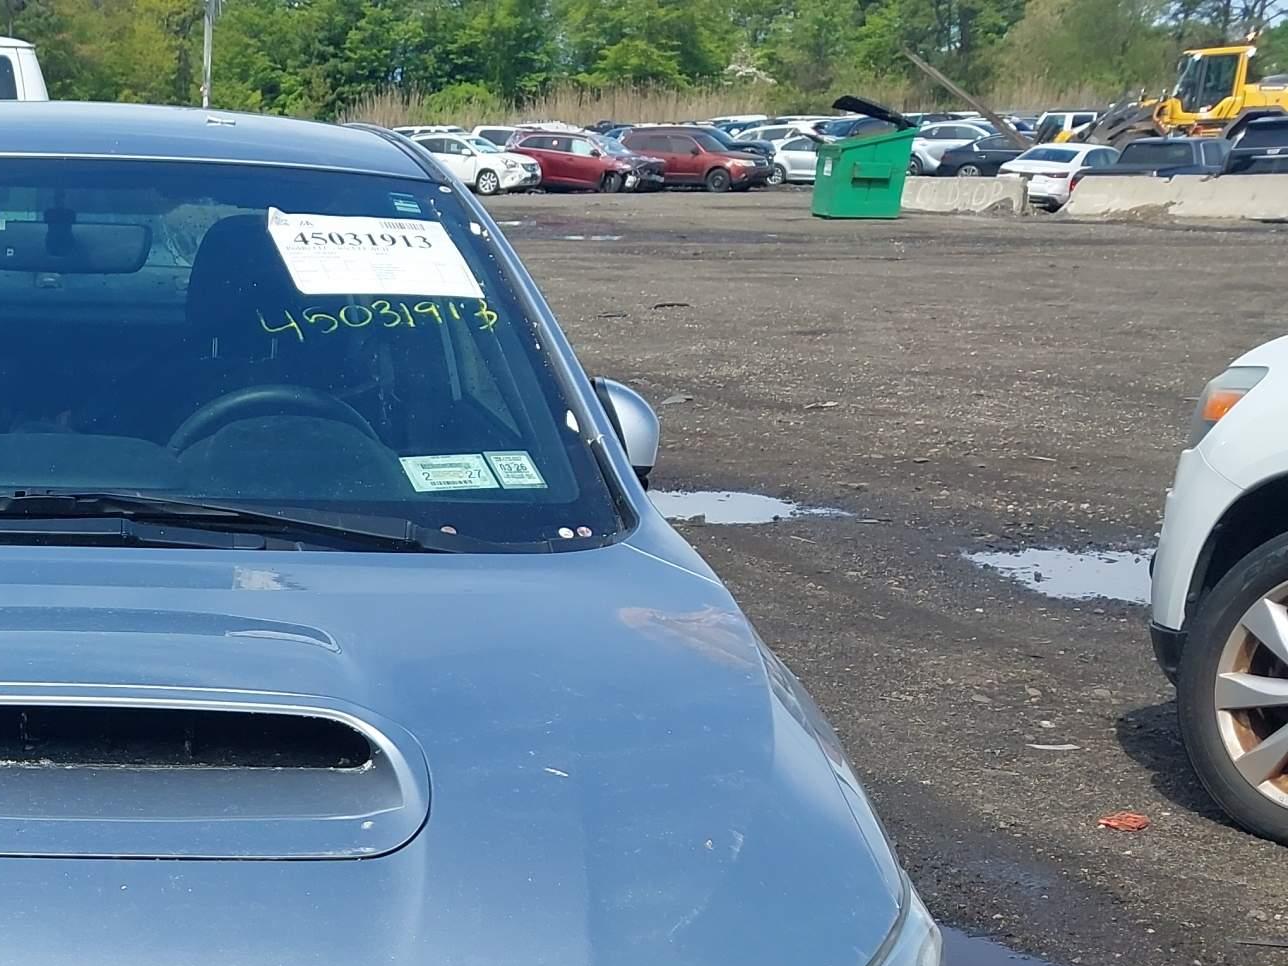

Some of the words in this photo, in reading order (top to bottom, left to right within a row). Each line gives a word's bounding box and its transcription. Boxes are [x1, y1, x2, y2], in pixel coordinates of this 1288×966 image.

[293, 231, 432, 248] 45031913
[256, 300, 498, 342] 45031913
[422, 472, 432, 481] 2
[466, 469, 481, 479] 27
